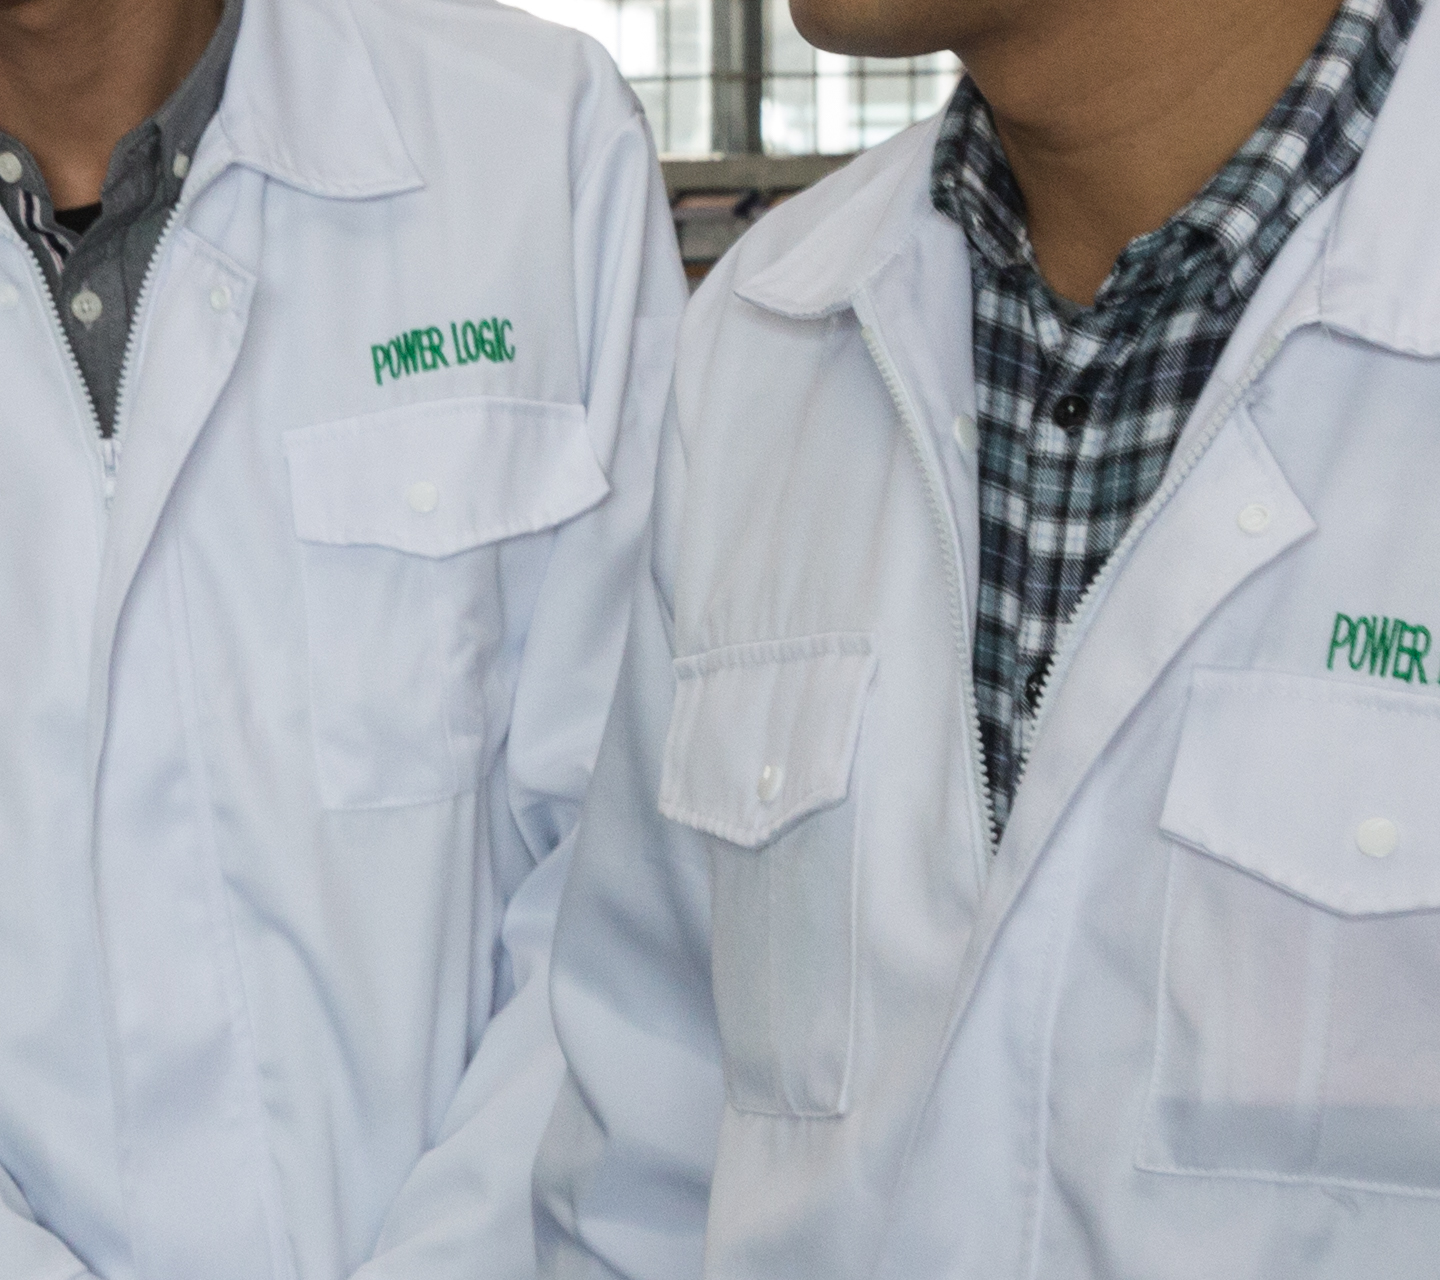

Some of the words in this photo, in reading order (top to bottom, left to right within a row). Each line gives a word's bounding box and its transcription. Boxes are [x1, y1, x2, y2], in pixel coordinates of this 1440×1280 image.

[371, 326, 449, 385] POWER
[451, 317, 515, 365] LOGIC
[1327, 613, 1431, 684] POWER
